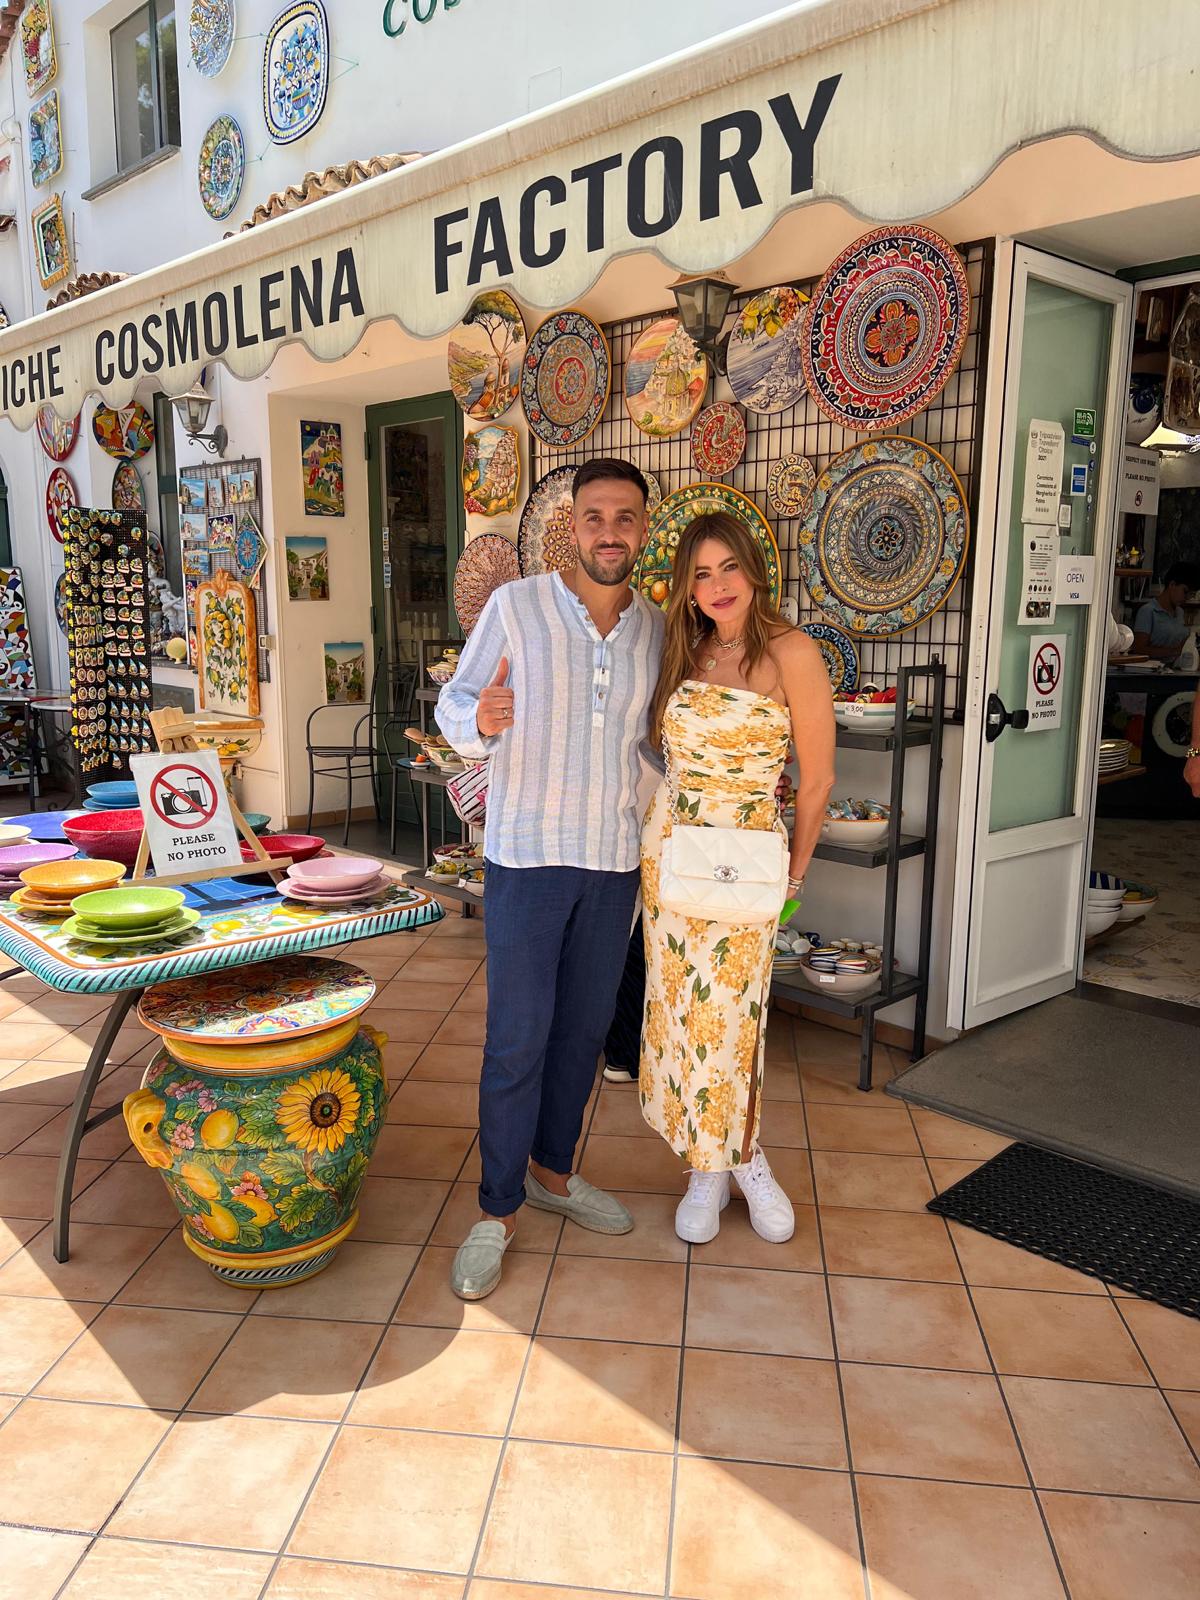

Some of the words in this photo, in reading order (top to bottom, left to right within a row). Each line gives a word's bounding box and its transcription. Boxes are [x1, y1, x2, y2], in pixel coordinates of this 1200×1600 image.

[2, 345, 64, 411] ICHE
[95, 247, 365, 386] COSMOLENA
[434, 73, 843, 295] FACTORY
[1066, 574, 1084, 583] OPEN
[851, 704, 863, 714] 3,00
[1040, 710, 1056, 719] PHOTO
[172, 833, 216, 846] PLEASE
[167, 852, 184, 862] NO
[188, 846, 226, 859] PHOTO
